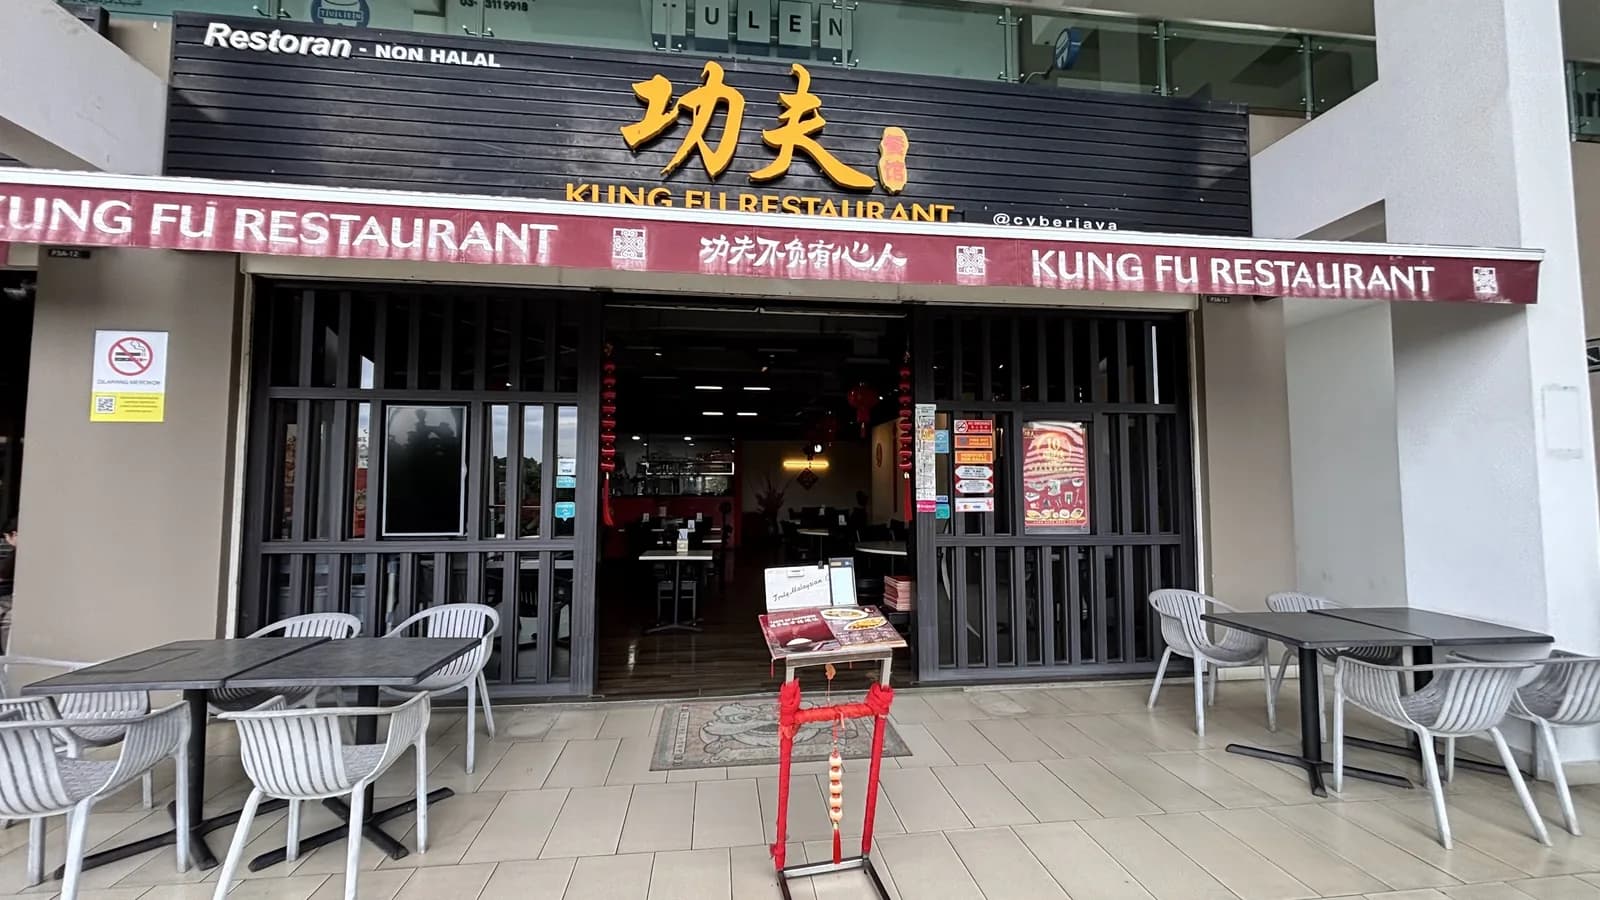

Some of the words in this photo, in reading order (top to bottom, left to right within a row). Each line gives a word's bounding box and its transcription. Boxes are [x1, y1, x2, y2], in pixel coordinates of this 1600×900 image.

[203, 22, 353, 59] Restoran
[375, 43, 424, 62] NON
[430, 49, 500, 67] HALAL
[618, 60, 877, 192] 功夫
[565, 182, 673, 207] KUNG
[685, 189, 727, 211] FU
[738, 193, 956, 222] RESTAURANT
[0, 195, 133, 234] UNG
[150, 202, 216, 238] FU
[233, 207, 558, 261] RESTAURANT
[699, 234, 907, 271] 功夫不负有心人
[1031, 249, 1144, 282] KUNG
[1154, 255, 1199, 285] FU
[1209, 257, 1436, 294] RESTAURANT
